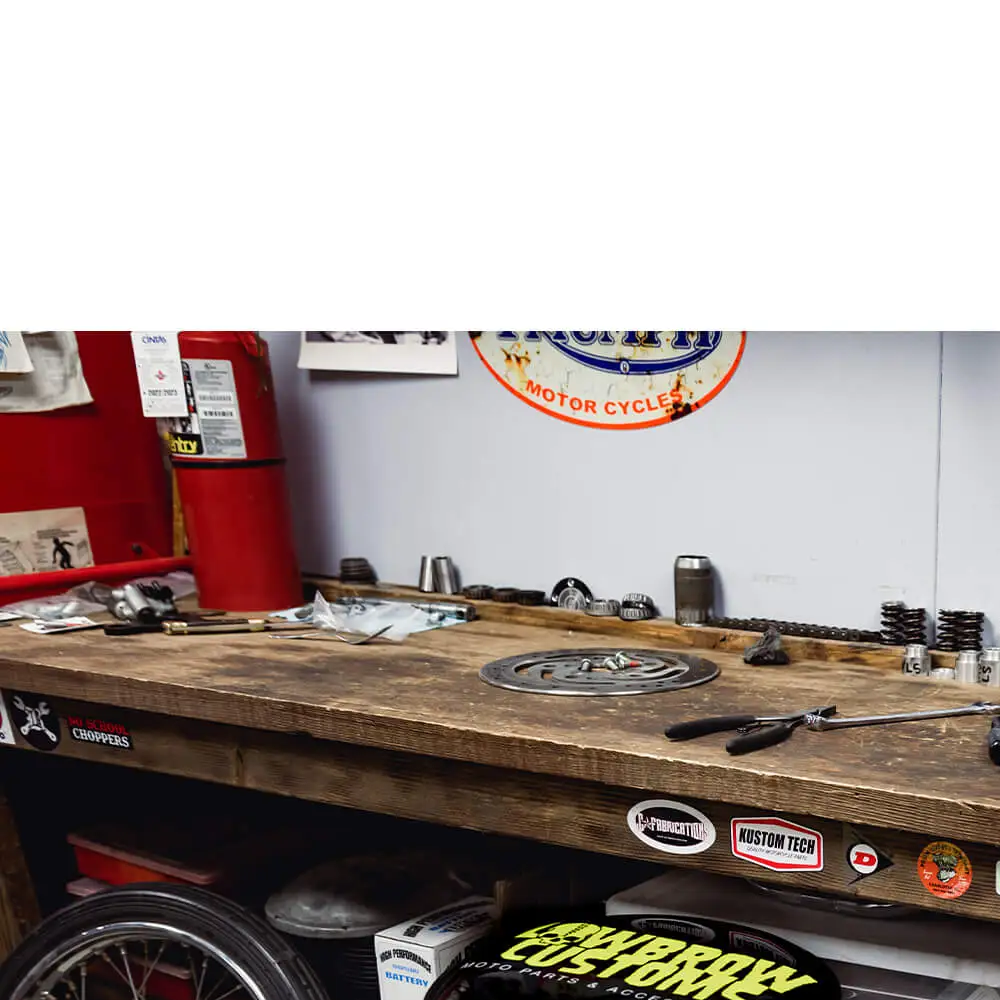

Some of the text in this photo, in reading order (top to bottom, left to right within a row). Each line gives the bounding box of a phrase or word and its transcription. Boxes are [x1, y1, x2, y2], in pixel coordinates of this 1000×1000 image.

[526, 379, 683, 415] MOTOR CYCLES
[72, 728, 130, 748] CHOPPERS
[739, 827, 815, 855] KUSTOM TECH
[514, 921, 817, 994] LOWBROW
[385, 971, 428, 987] BATTERY
[460, 961, 514, 973] MOTO
[519, 967, 578, 985] PARTS
